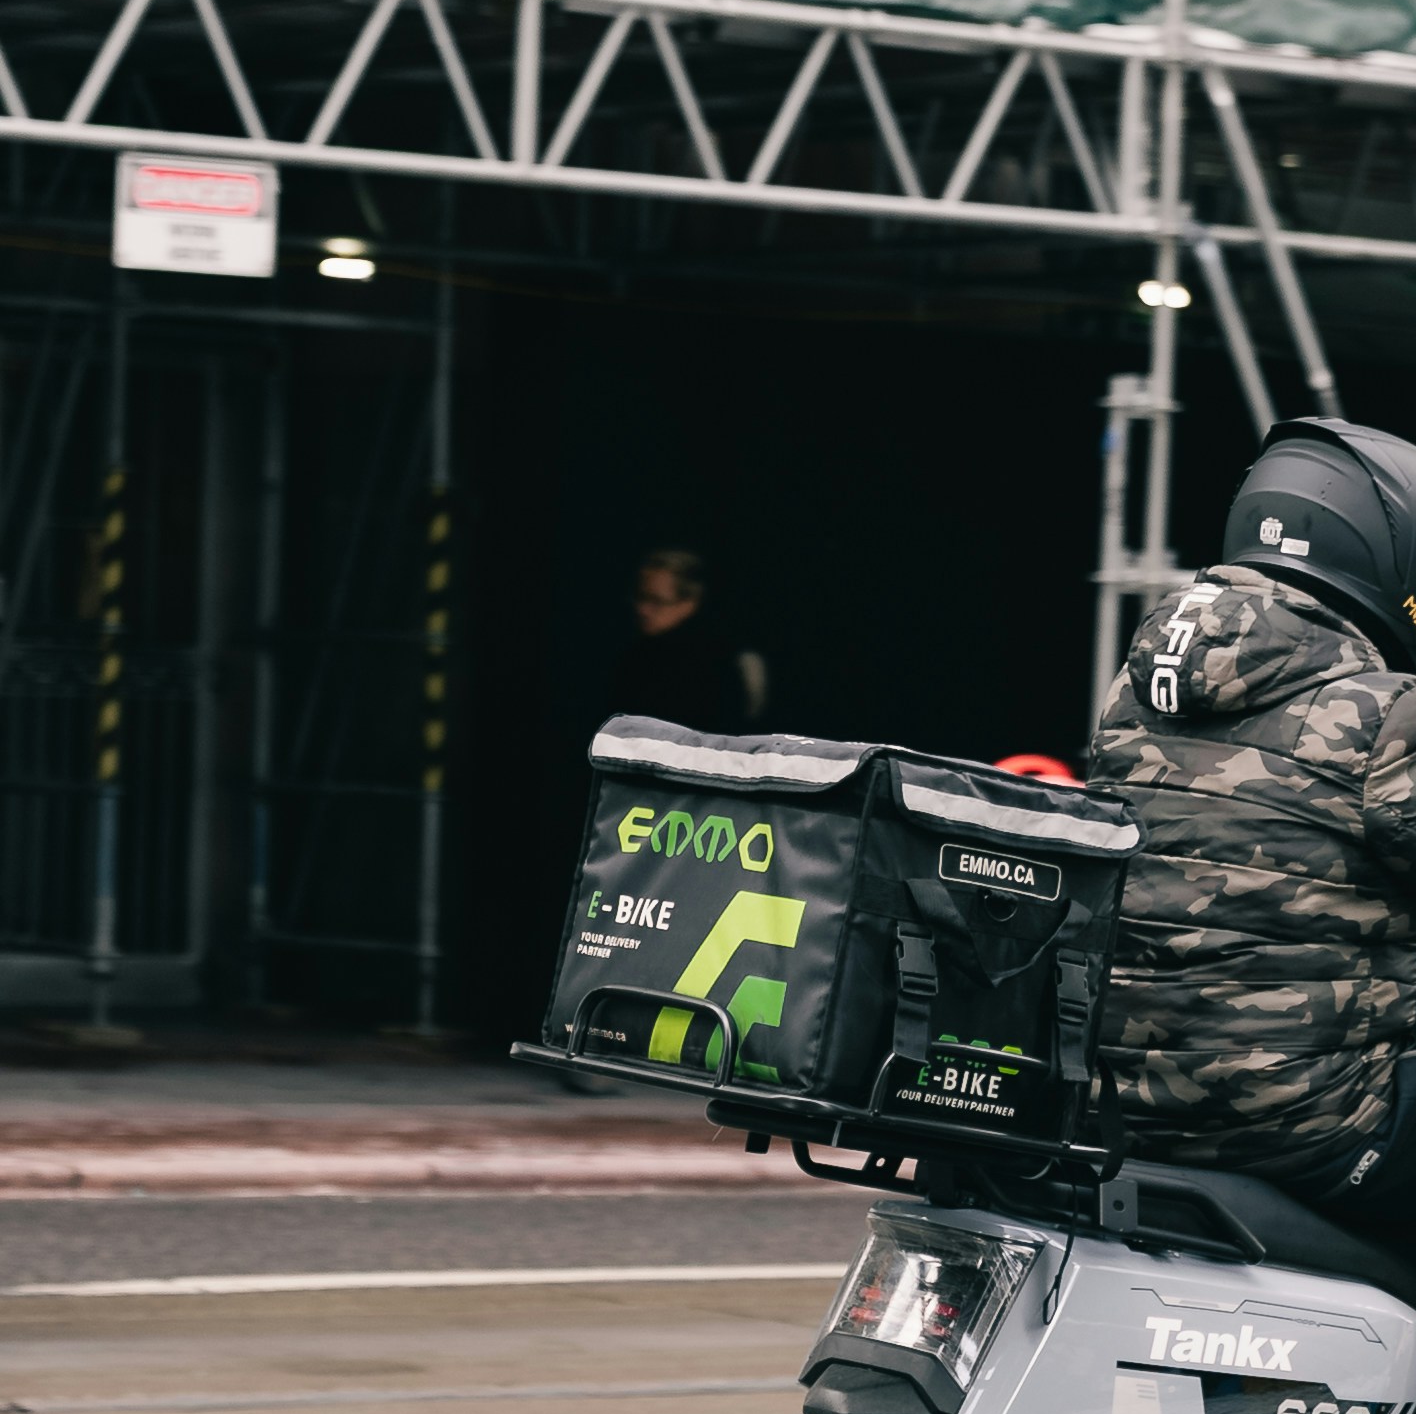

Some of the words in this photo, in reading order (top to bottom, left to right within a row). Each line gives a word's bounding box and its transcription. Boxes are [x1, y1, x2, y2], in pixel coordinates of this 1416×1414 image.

[960, 853, 1035, 886] EMMO.CA
[576, 943, 612, 959] PARTNER
[580, 931, 605, 945] YOUR
[604, 935, 641, 950] DELIVERY
[1145, 1316, 1299, 1372] Tankx
